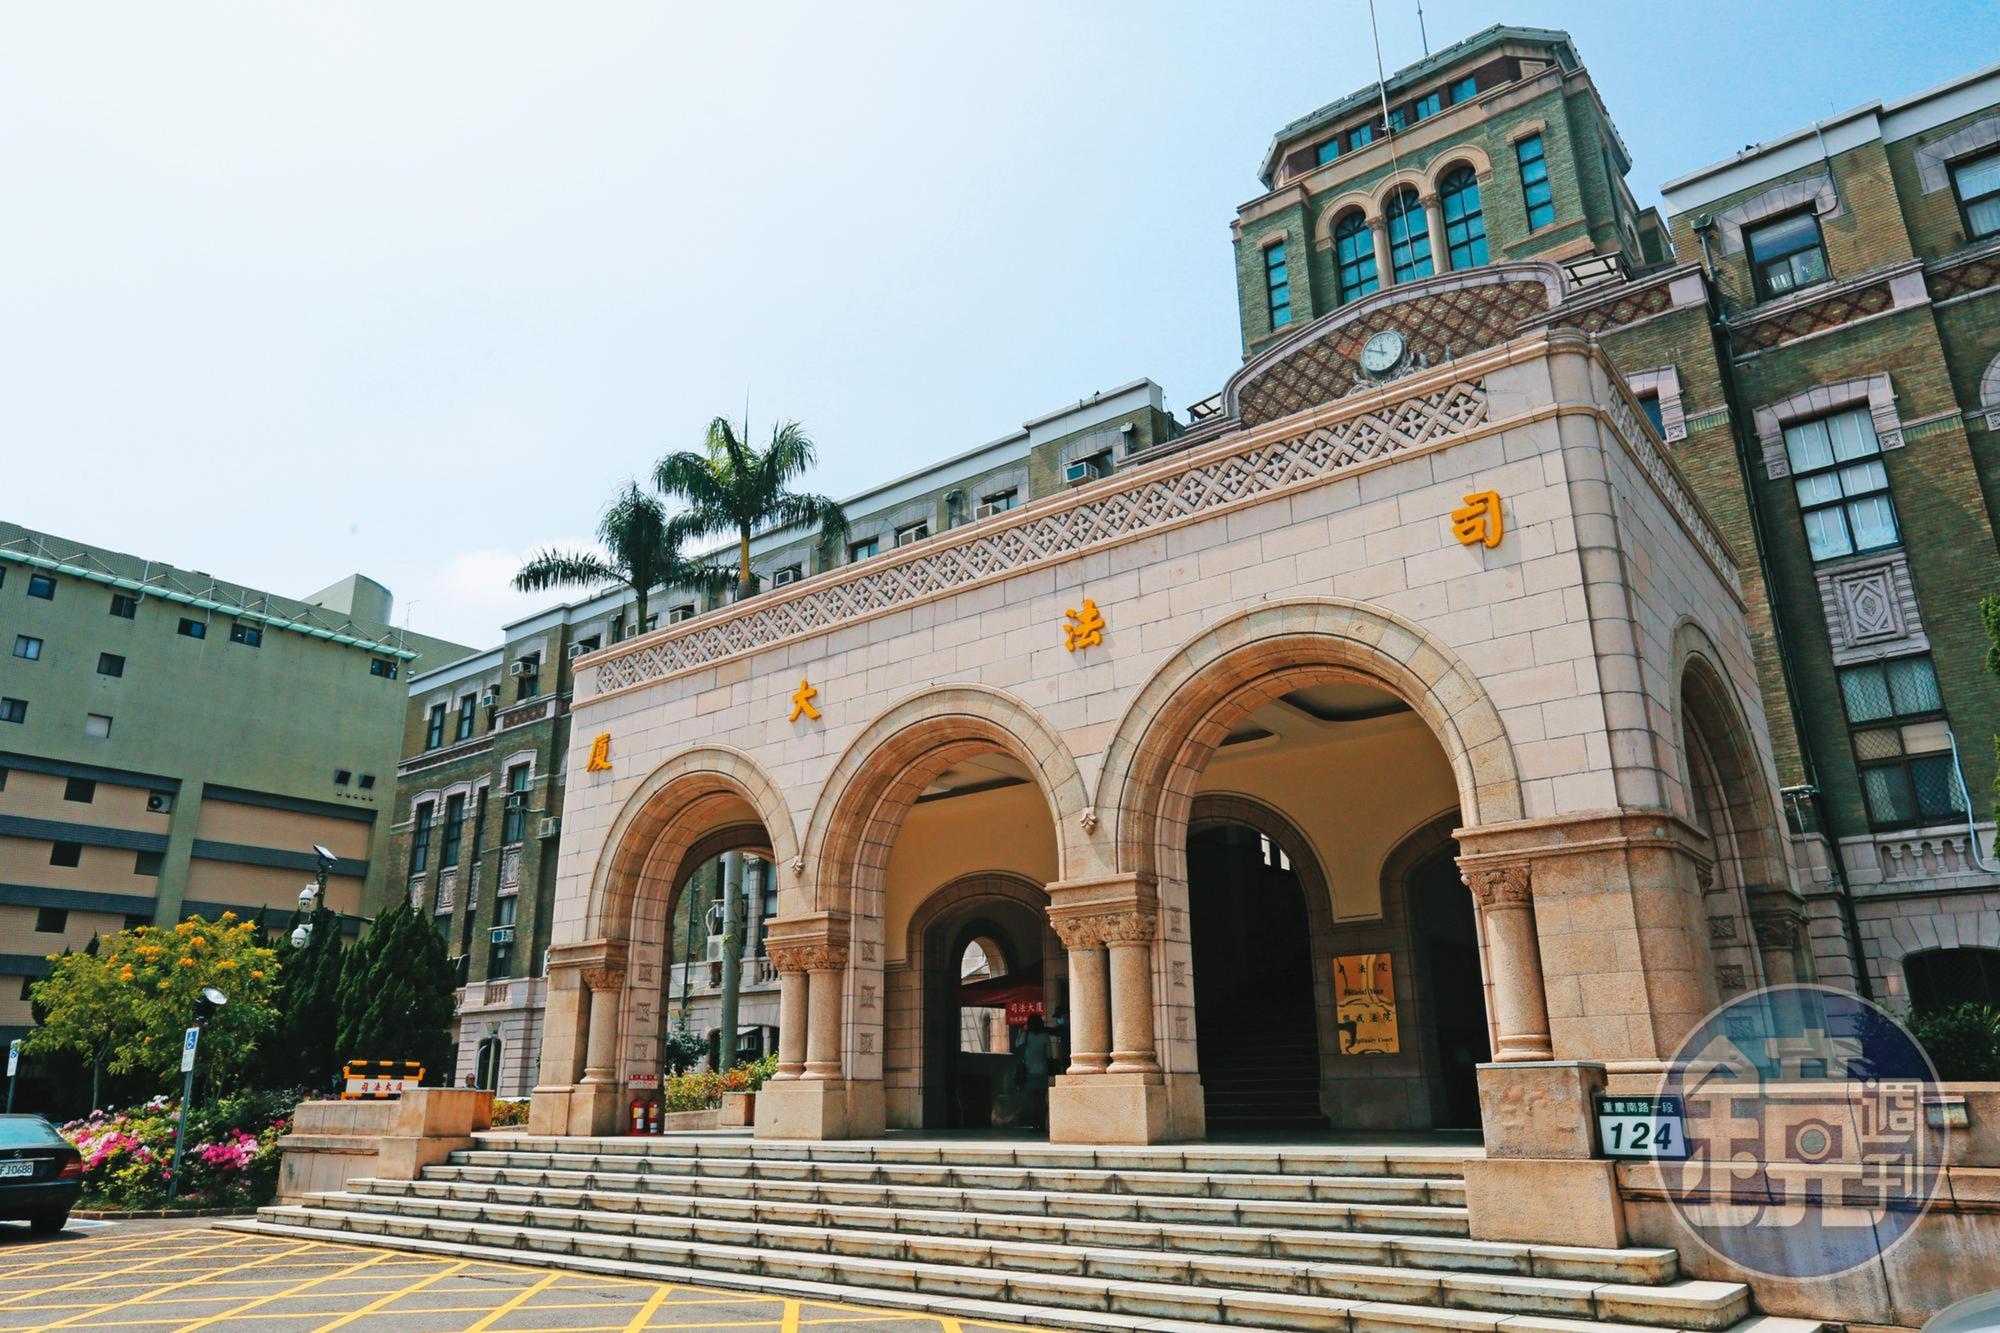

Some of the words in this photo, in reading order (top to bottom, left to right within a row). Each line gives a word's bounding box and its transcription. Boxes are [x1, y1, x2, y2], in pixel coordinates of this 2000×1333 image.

[1602, 1101, 1674, 1113] 重慶南路一段
[1610, 1122, 1672, 1150] 124
